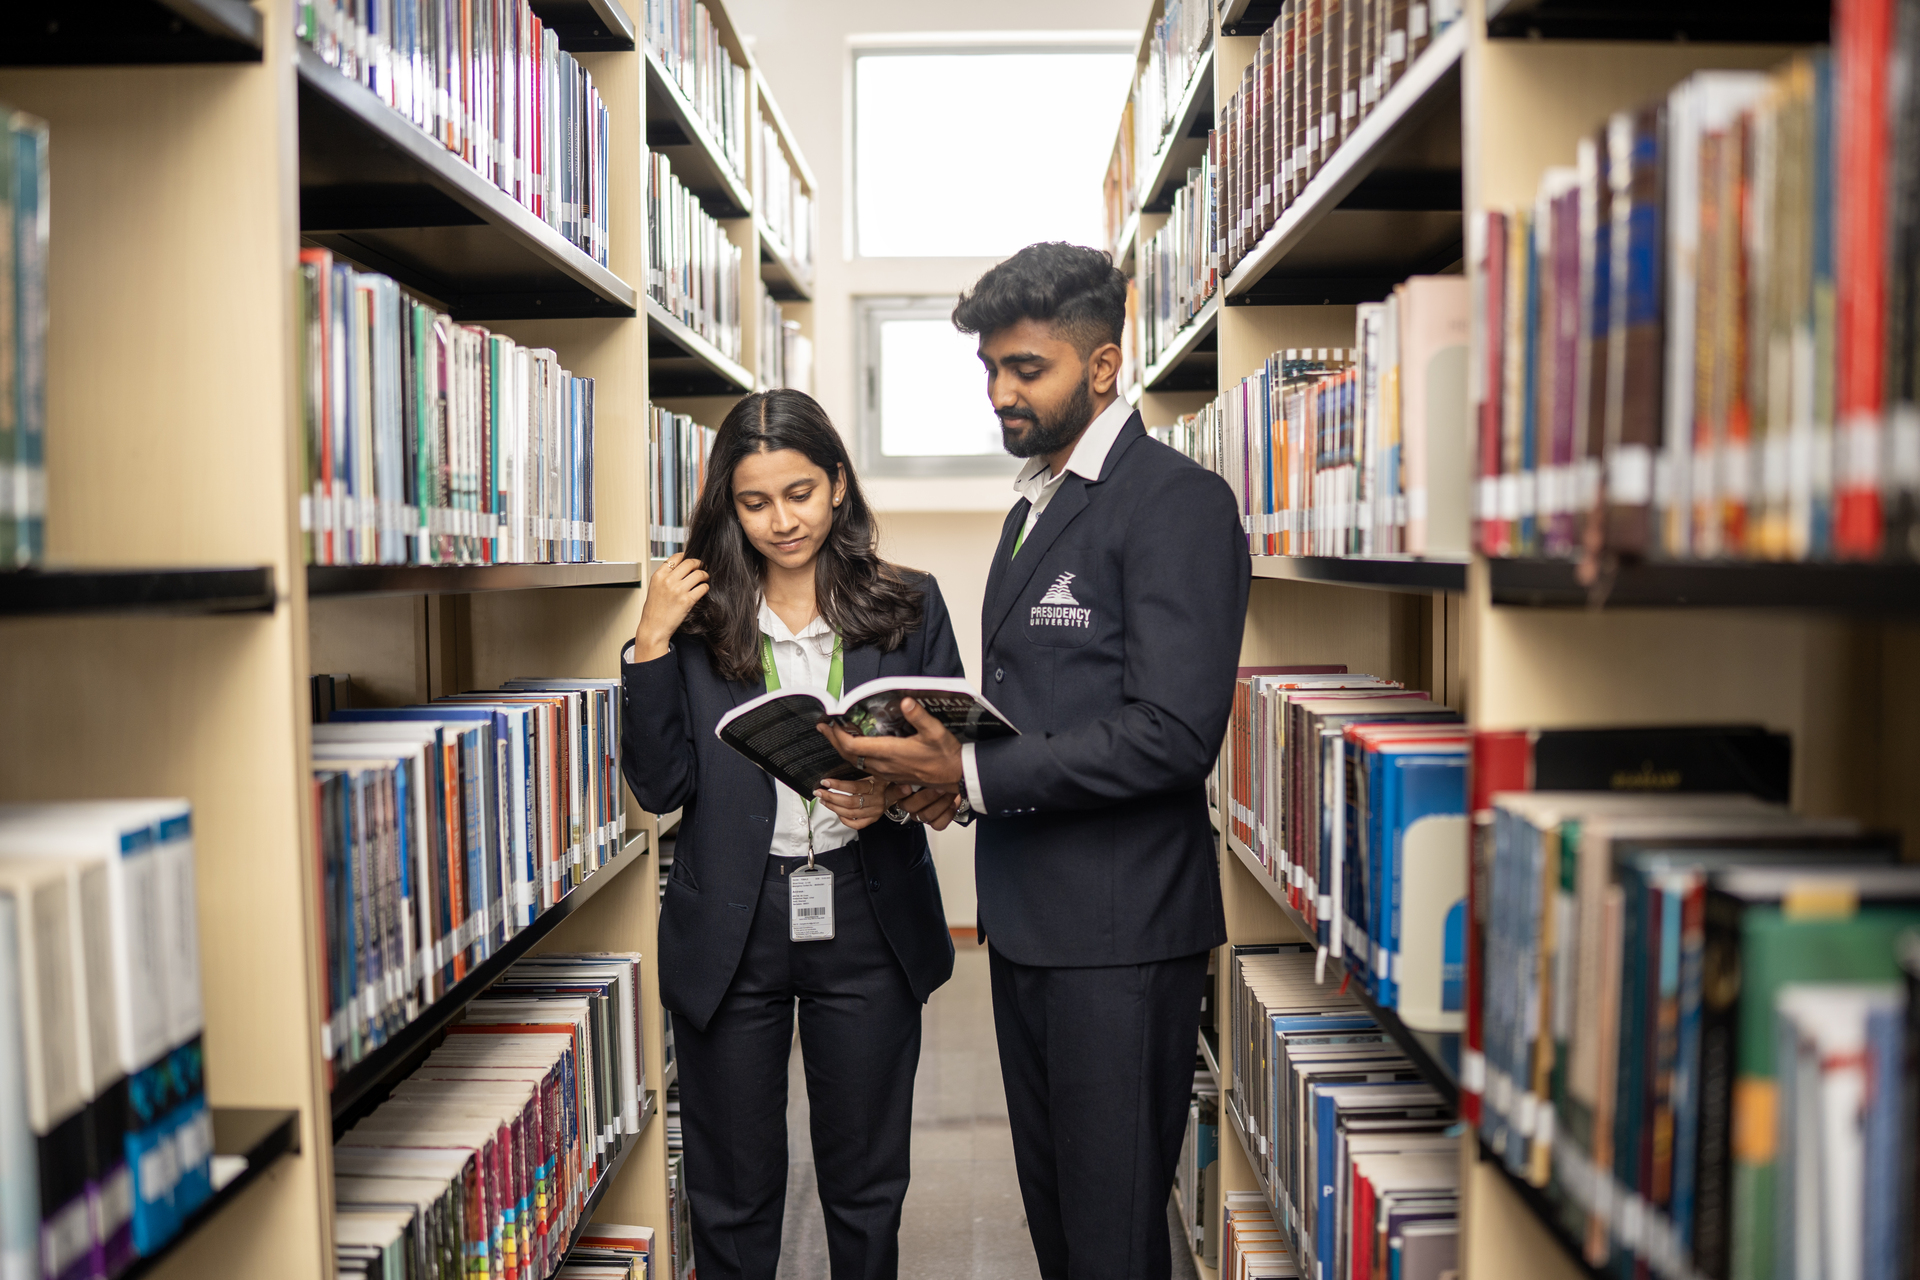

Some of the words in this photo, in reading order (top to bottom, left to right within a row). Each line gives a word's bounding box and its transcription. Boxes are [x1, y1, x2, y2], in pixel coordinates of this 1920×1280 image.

[1031, 607, 1091, 620] PRESIDENCY
[1030, 618, 1089, 628] UNIVERSITY
[916, 698, 974, 708] JURIS
